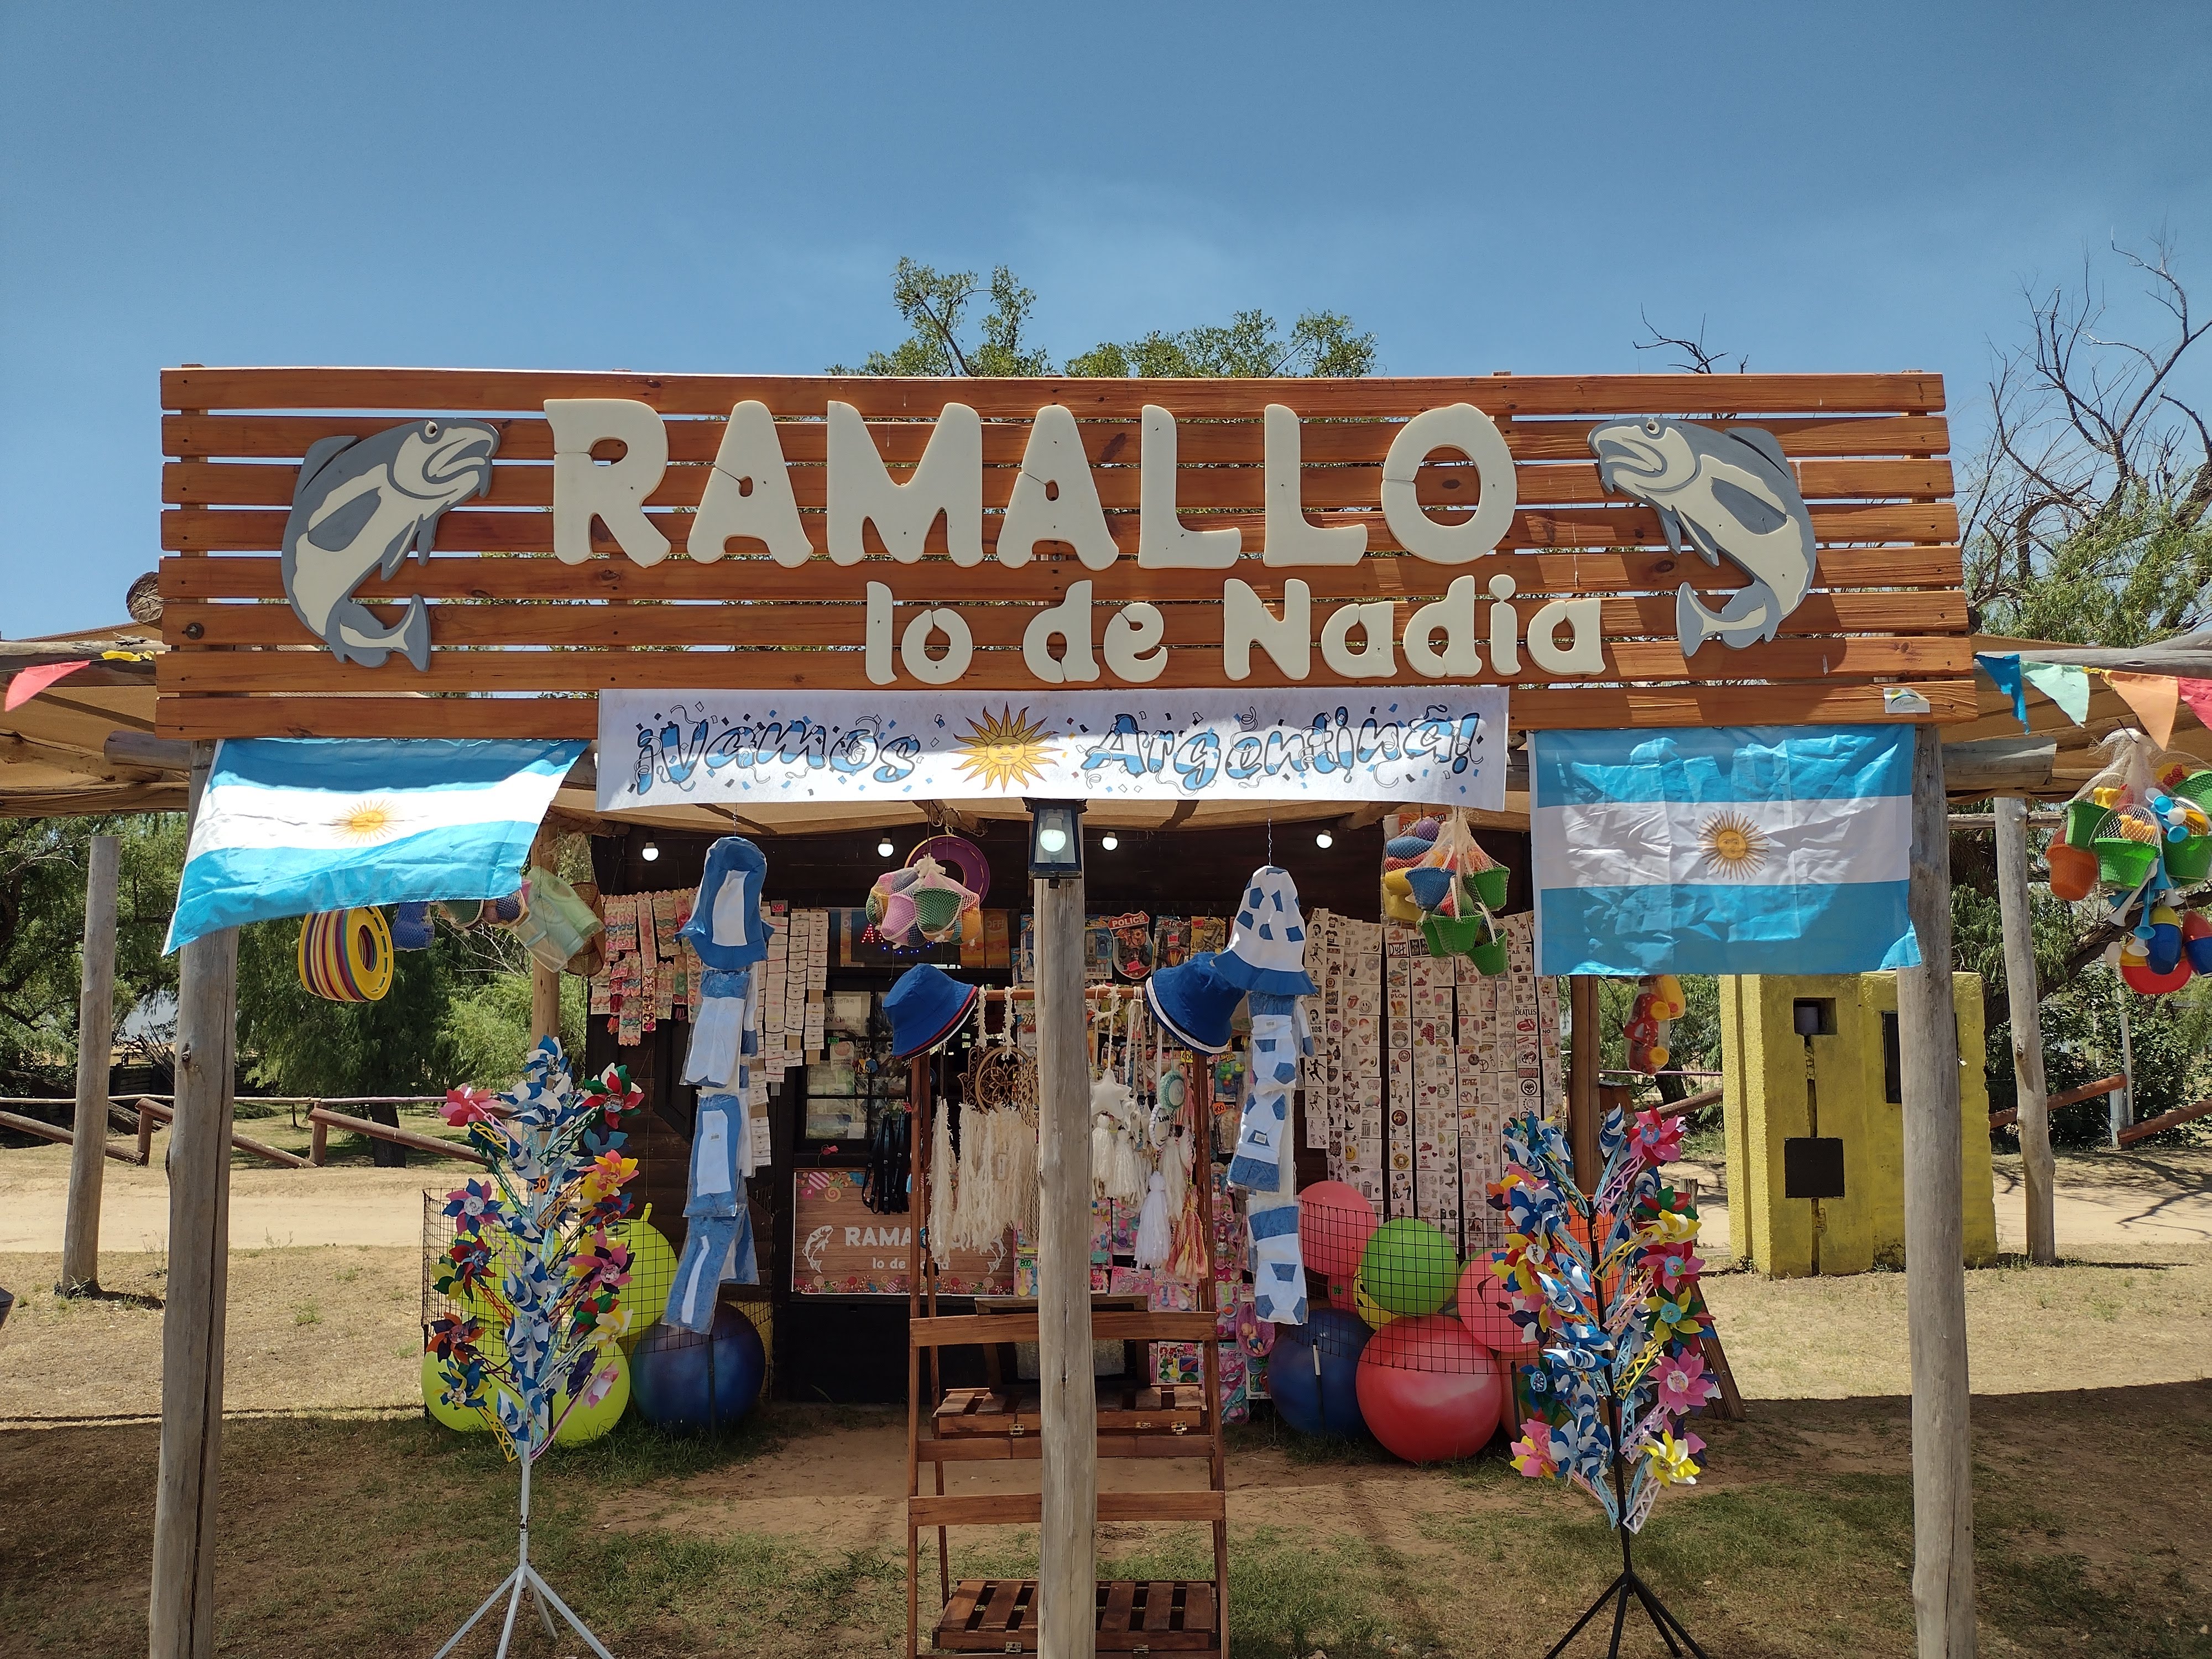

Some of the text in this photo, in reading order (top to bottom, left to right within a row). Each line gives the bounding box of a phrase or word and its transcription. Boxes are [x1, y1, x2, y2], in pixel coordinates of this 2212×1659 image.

[542, 398, 1519, 569] RAMALLO
[865, 573, 1606, 685] lo de Nadia
[637, 706, 1480, 795] ¡Vamos Argentina!
[986, 919, 1005, 928] OFF!
[1112, 916, 1145, 927] POLICE
[1389, 943, 1406, 956] Duff
[1515, 1006, 1537, 1016] BEATLES
[873, 1257, 906, 1269] lo de
[1020, 1259, 1032, 1267] 800
